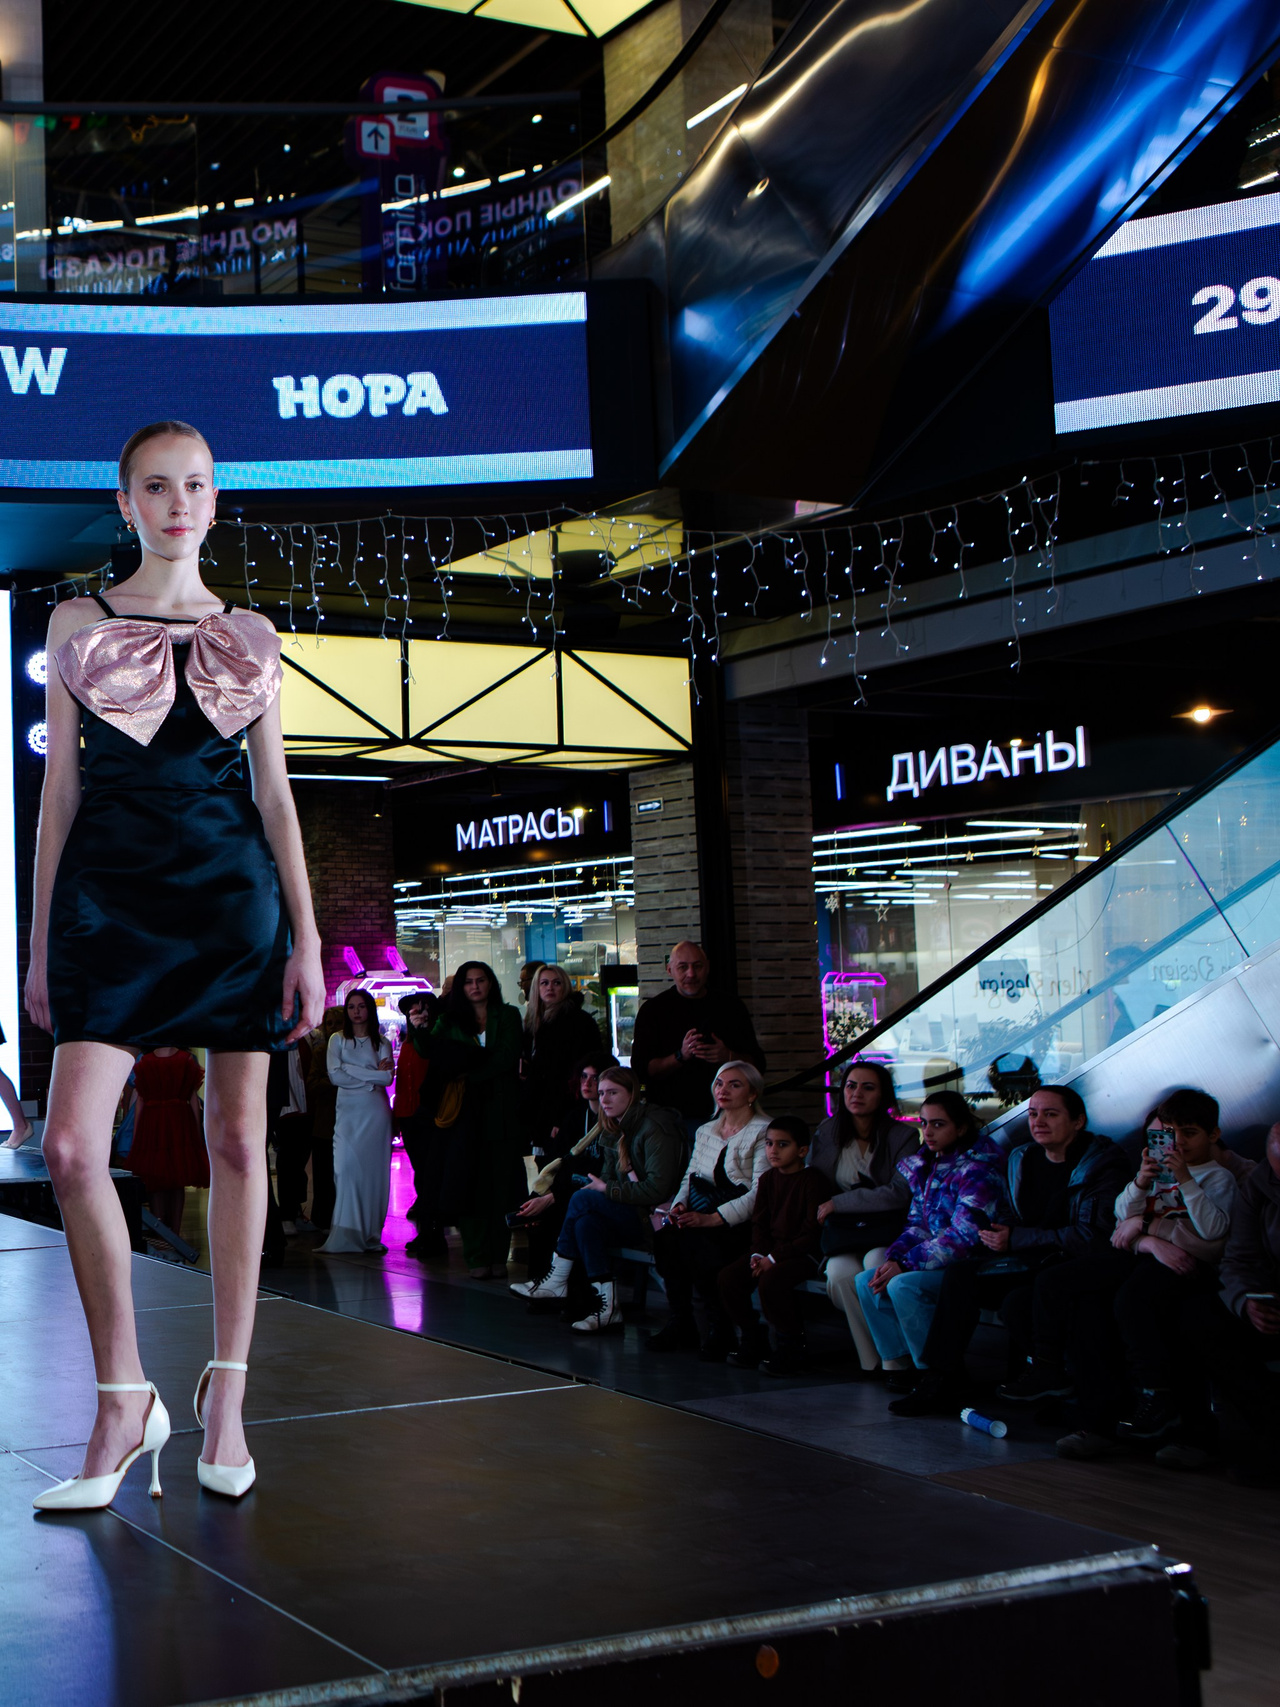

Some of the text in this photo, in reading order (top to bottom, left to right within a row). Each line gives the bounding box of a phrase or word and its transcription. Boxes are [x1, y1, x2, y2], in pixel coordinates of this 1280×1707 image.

[1192, 276, 1280, 335] 29
[273, 372, 448, 419] НОРА
[886, 725, 1087, 801] ДИВАНЫ
[456, 807, 582, 851] МАТРАСЫ
